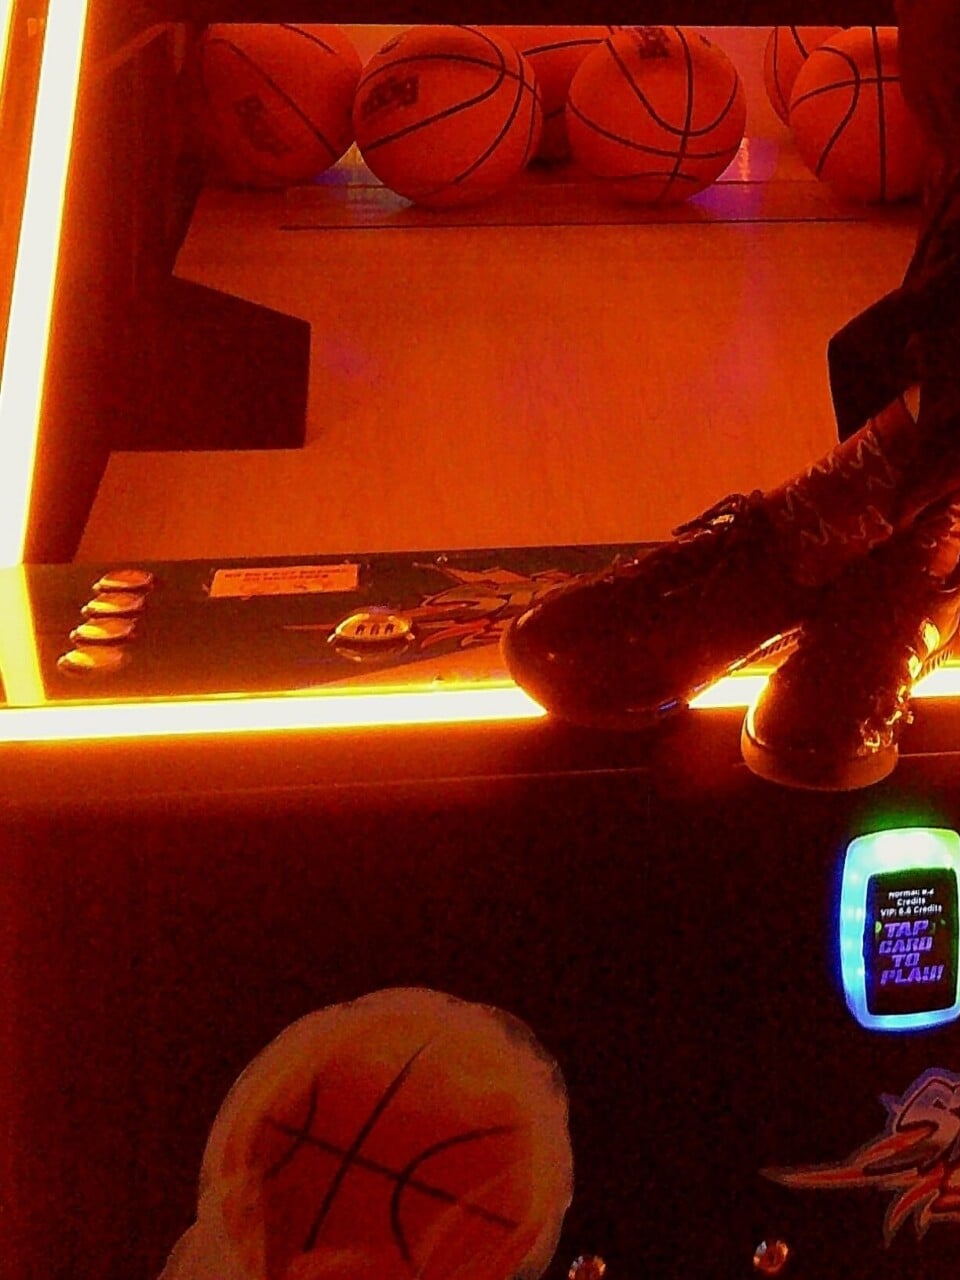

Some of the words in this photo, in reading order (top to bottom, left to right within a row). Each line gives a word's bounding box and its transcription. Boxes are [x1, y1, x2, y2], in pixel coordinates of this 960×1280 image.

[897, 896, 926, 906] Credits
[913, 903, 943, 915] Credits
[884, 919, 929, 938] TAP
[879, 936, 933, 954] CARD
[892, 952, 920, 968] TO
